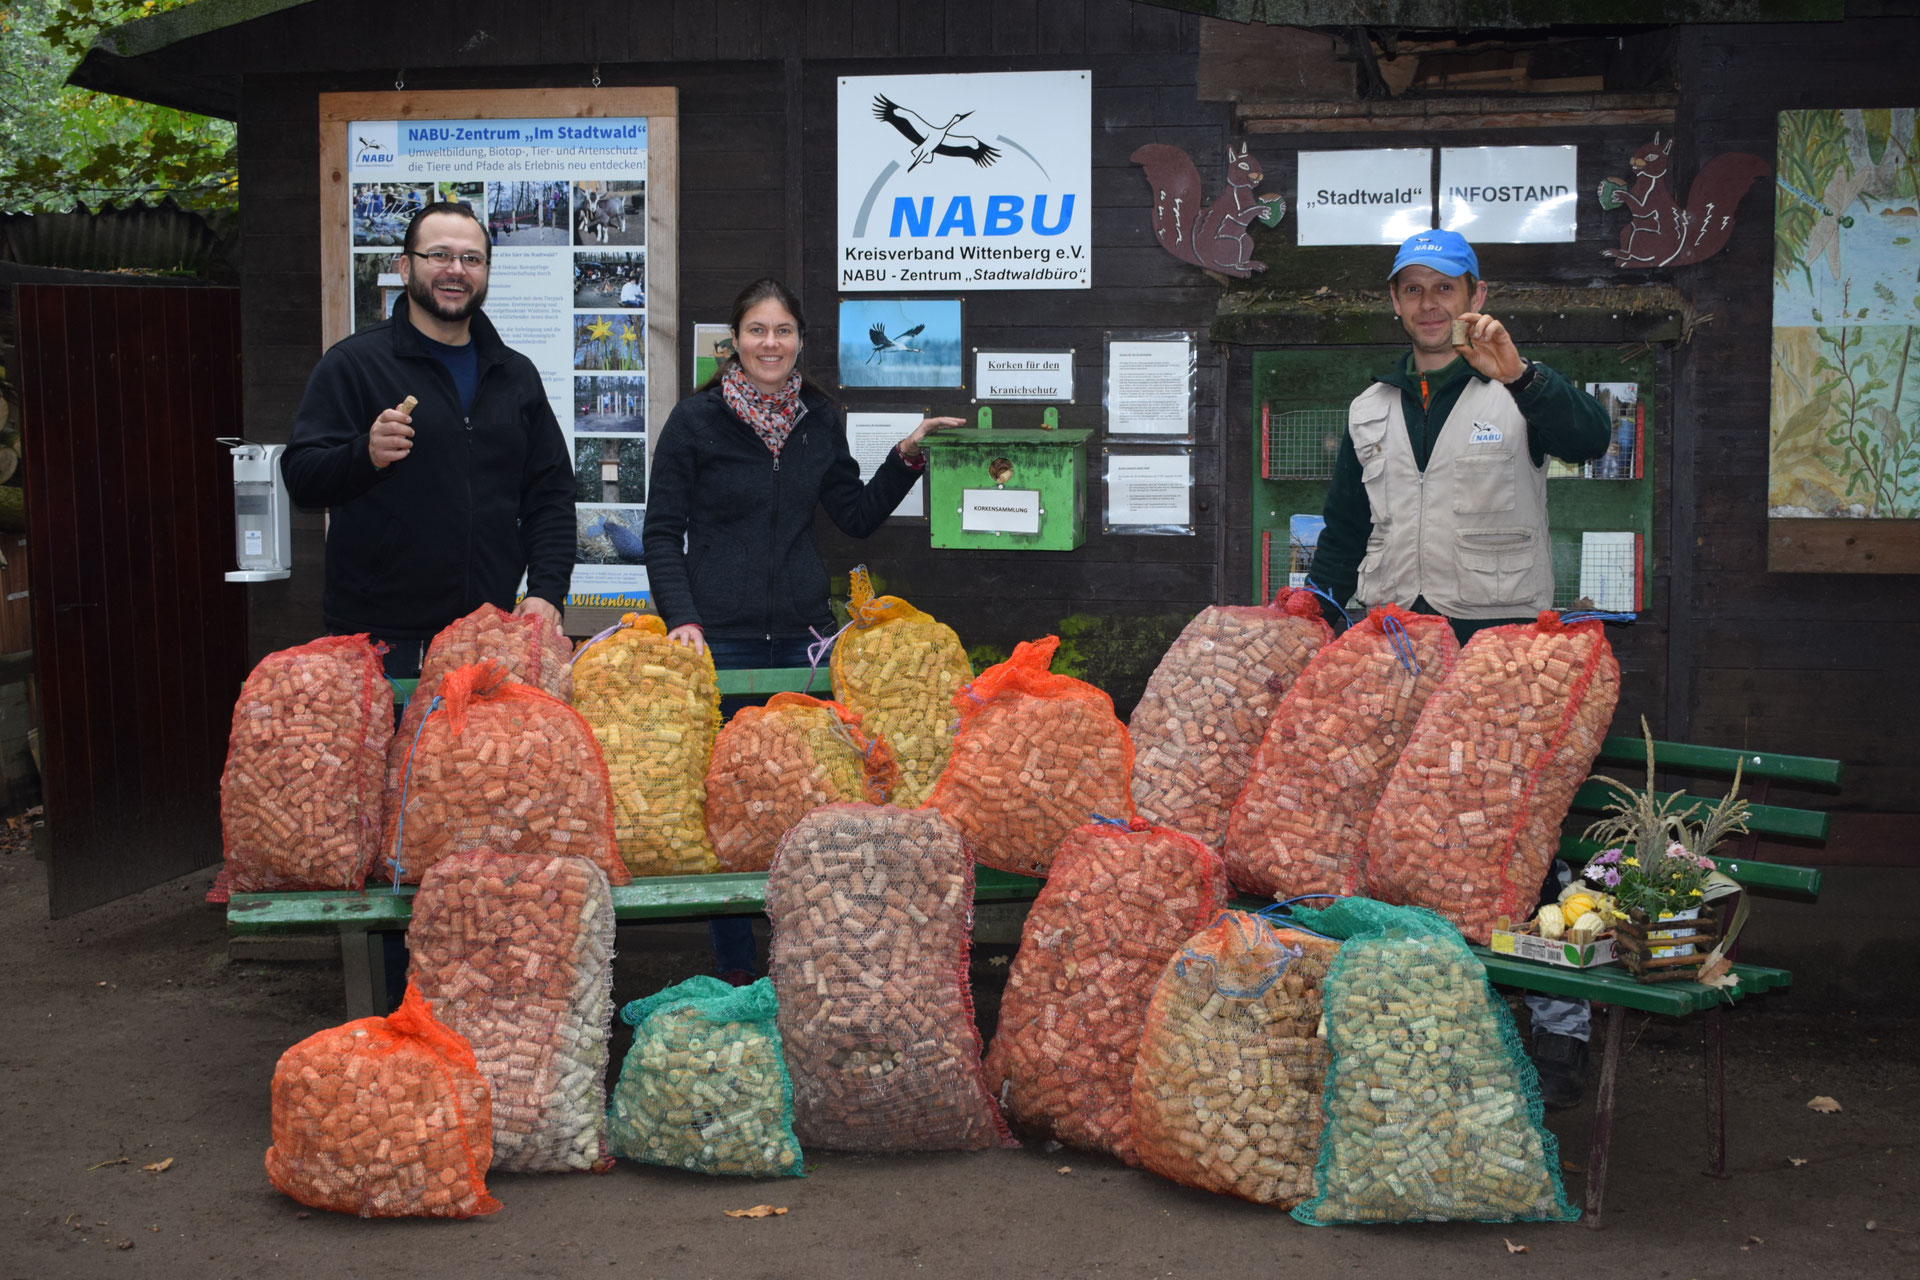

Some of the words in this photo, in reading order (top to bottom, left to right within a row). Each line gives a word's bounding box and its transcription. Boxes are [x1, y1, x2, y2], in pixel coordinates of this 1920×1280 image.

[409, 128, 520, 141] NABU-Zentrum
[361, 154, 394, 162] NABU
[408, 147, 487, 158] Umweltbildung,
[489, 147, 529, 158] Biotop-,
[531, 146, 553, 156] Tier-
[556, 146, 576, 156] und
[578, 145, 638, 156] Artenschutz
[408, 162, 423, 172] die
[426, 162, 450, 172] Tiere
[454, 161, 473, 171] und
[476, 161, 504, 171] Pfade
[507, 160, 521, 170] als
[525, 160, 565, 170] Erlebnis
[568, 162, 586, 170] neu
[589, 159, 646, 170] entdecken!
[1448, 185, 1569, 202] INFOSTAND
[889, 194, 1076, 238] NABU
[845, 246, 954, 261] Kreisverband
[959, 245, 1050, 262] Wittenberg
[1055, 245, 1085, 260] e.V.
[1414, 244, 1443, 252] NABU
[843, 268, 887, 282] NABU
[900, 269, 962, 281] Zentrum
[988, 360, 1023, 370] Korken
[1026, 360, 1040, 370] für
[1042, 360, 1060, 370] den
[990, 386, 1058, 395] Kranichschutz
[1476, 434, 1502, 442] NABU
[974, 505, 1028, 513] KORKENSAMMLUNG
[571, 593, 647, 608] Wittenberg
